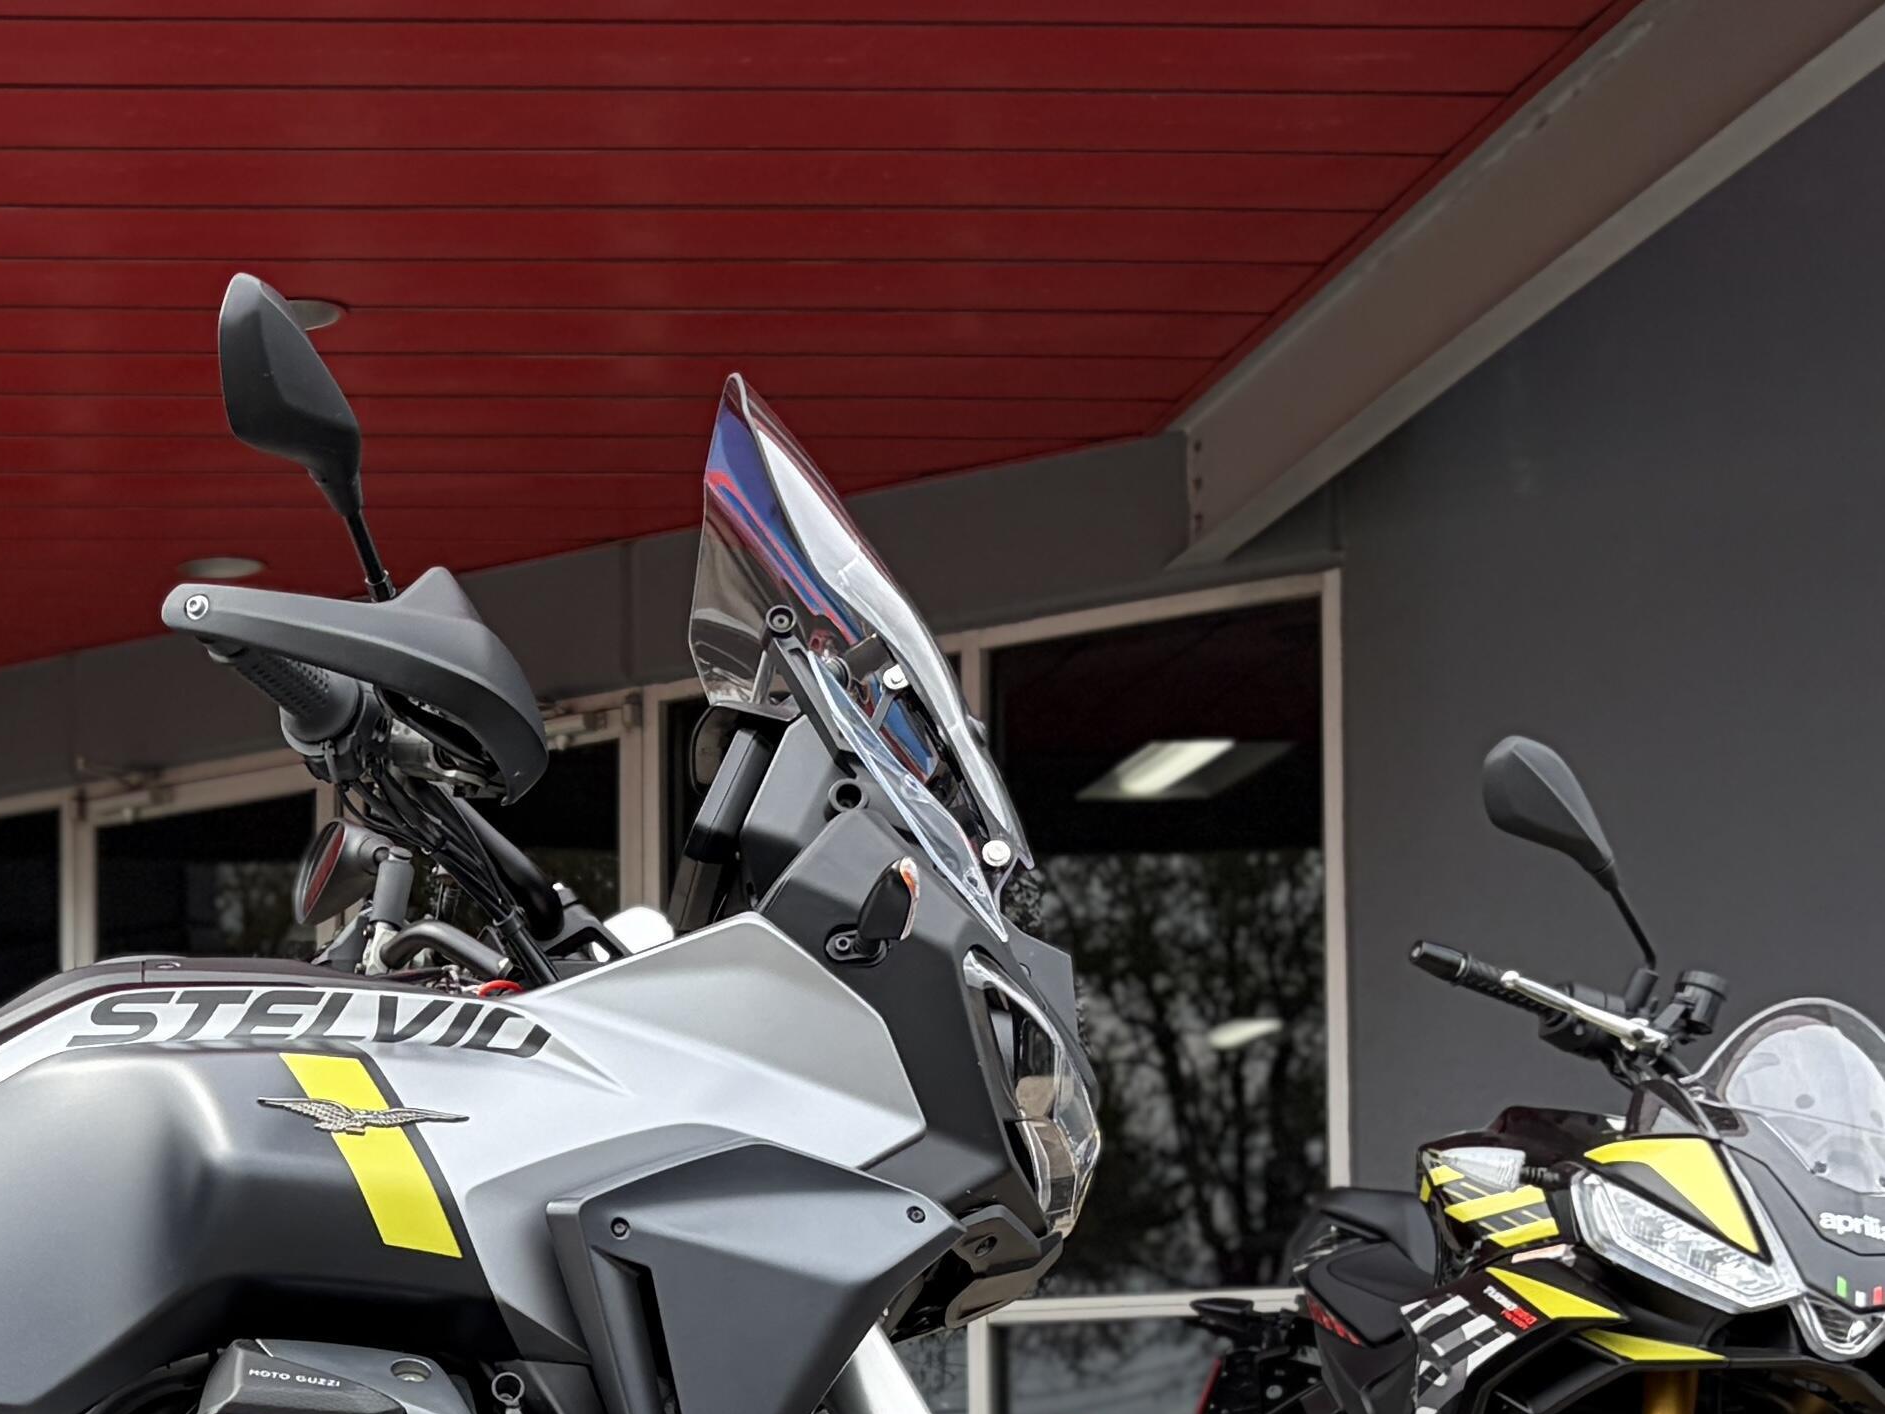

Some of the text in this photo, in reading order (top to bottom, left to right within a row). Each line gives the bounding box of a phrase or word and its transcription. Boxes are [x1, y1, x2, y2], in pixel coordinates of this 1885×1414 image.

[67, 989, 553, 1058] STELVIO
[248, 1368, 341, 1388] MOTO GUZZI
